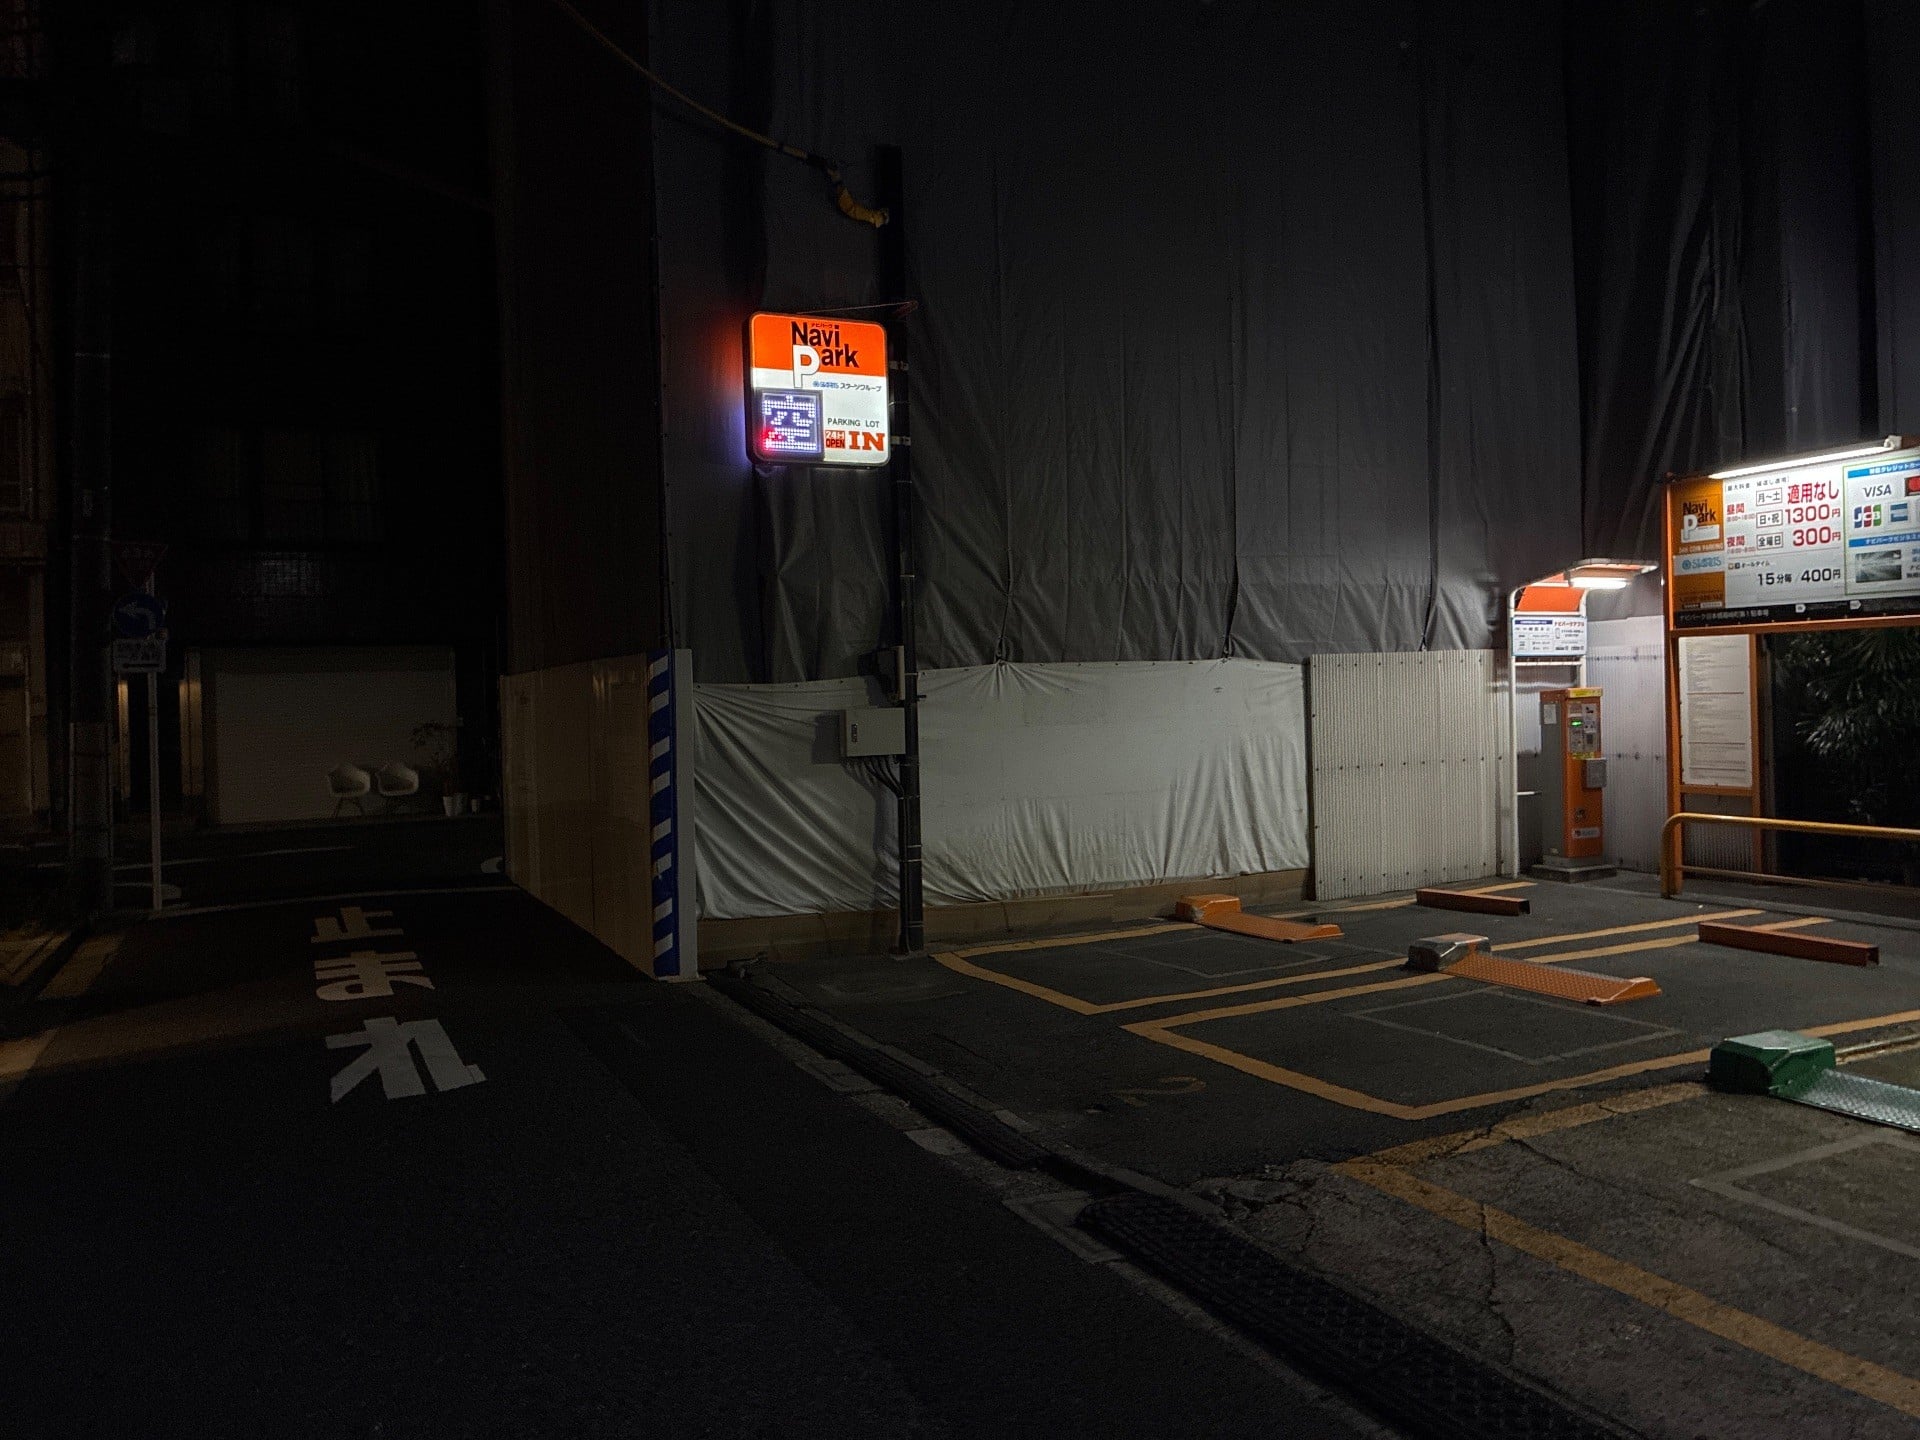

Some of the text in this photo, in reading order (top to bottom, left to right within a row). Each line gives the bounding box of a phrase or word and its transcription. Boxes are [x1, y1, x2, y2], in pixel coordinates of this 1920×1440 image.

[791, 321, 840, 347] Navi
[792, 344, 860, 388] Park
[763, 395, 816, 450] 空
[828, 418, 880, 428] PARKING LOT
[826, 439, 845, 448] OPEN
[849, 431, 885, 451] IN
[1787, 480, 1839, 505] 適用なし
[1863, 484, 1892, 497] VISA
[1683, 499, 1708, 516] Navi
[1727, 503, 1745, 516] 昼間
[1853, 504, 1882, 528] JCB
[1683, 509, 1716, 541] Park
[1727, 535, 1745, 548] 夜間
[1801, 568, 1841, 583] 400円
[311, 905, 489, 1104] 止まれ
